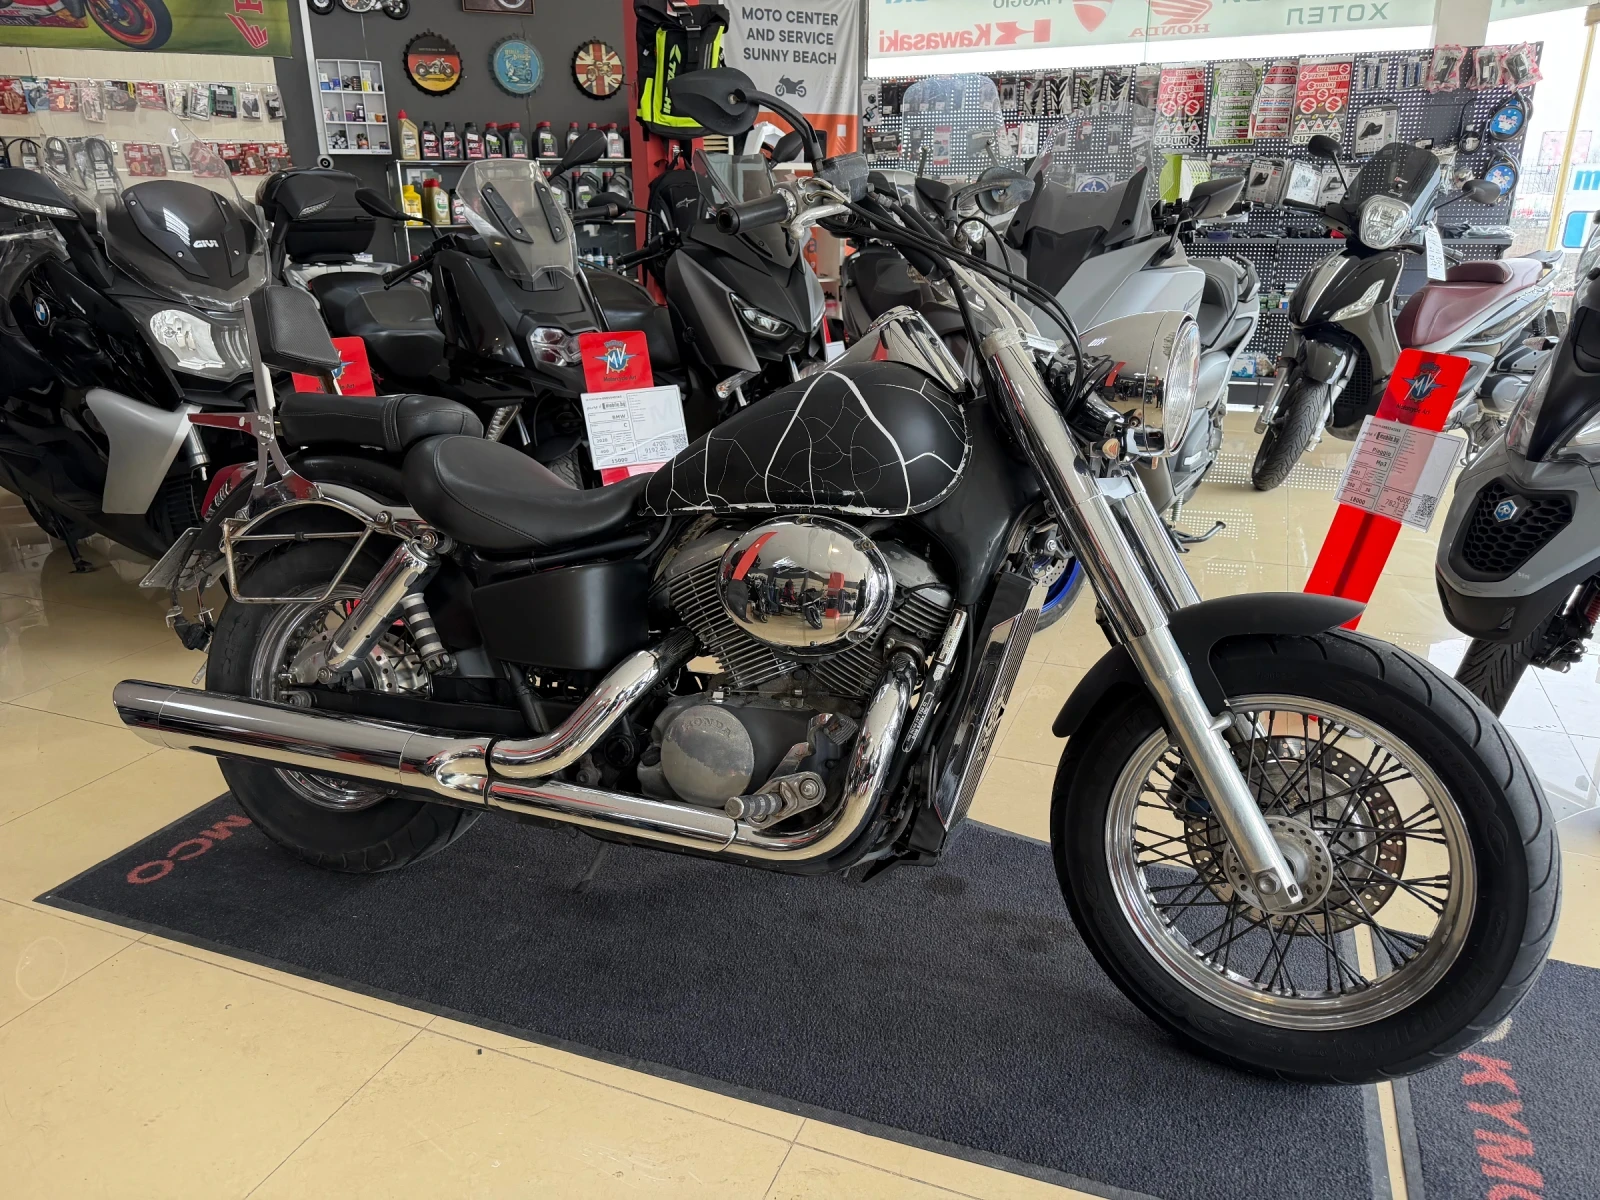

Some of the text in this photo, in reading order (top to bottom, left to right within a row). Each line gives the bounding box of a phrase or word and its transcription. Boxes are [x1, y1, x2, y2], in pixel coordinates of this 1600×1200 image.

[742, 6, 839, 26] MOTO CENTER
[746, 27, 834, 46] AND SERVICE
[743, 47, 837, 65] SUNNY BEACH
[193, 240, 219, 248] GIVI
[606, 343, 627, 375] MV
[1403, 369, 1442, 400] MV
[1372, 447, 1391, 457] Piaggio
[1376, 460, 1388, 468] Mp3
